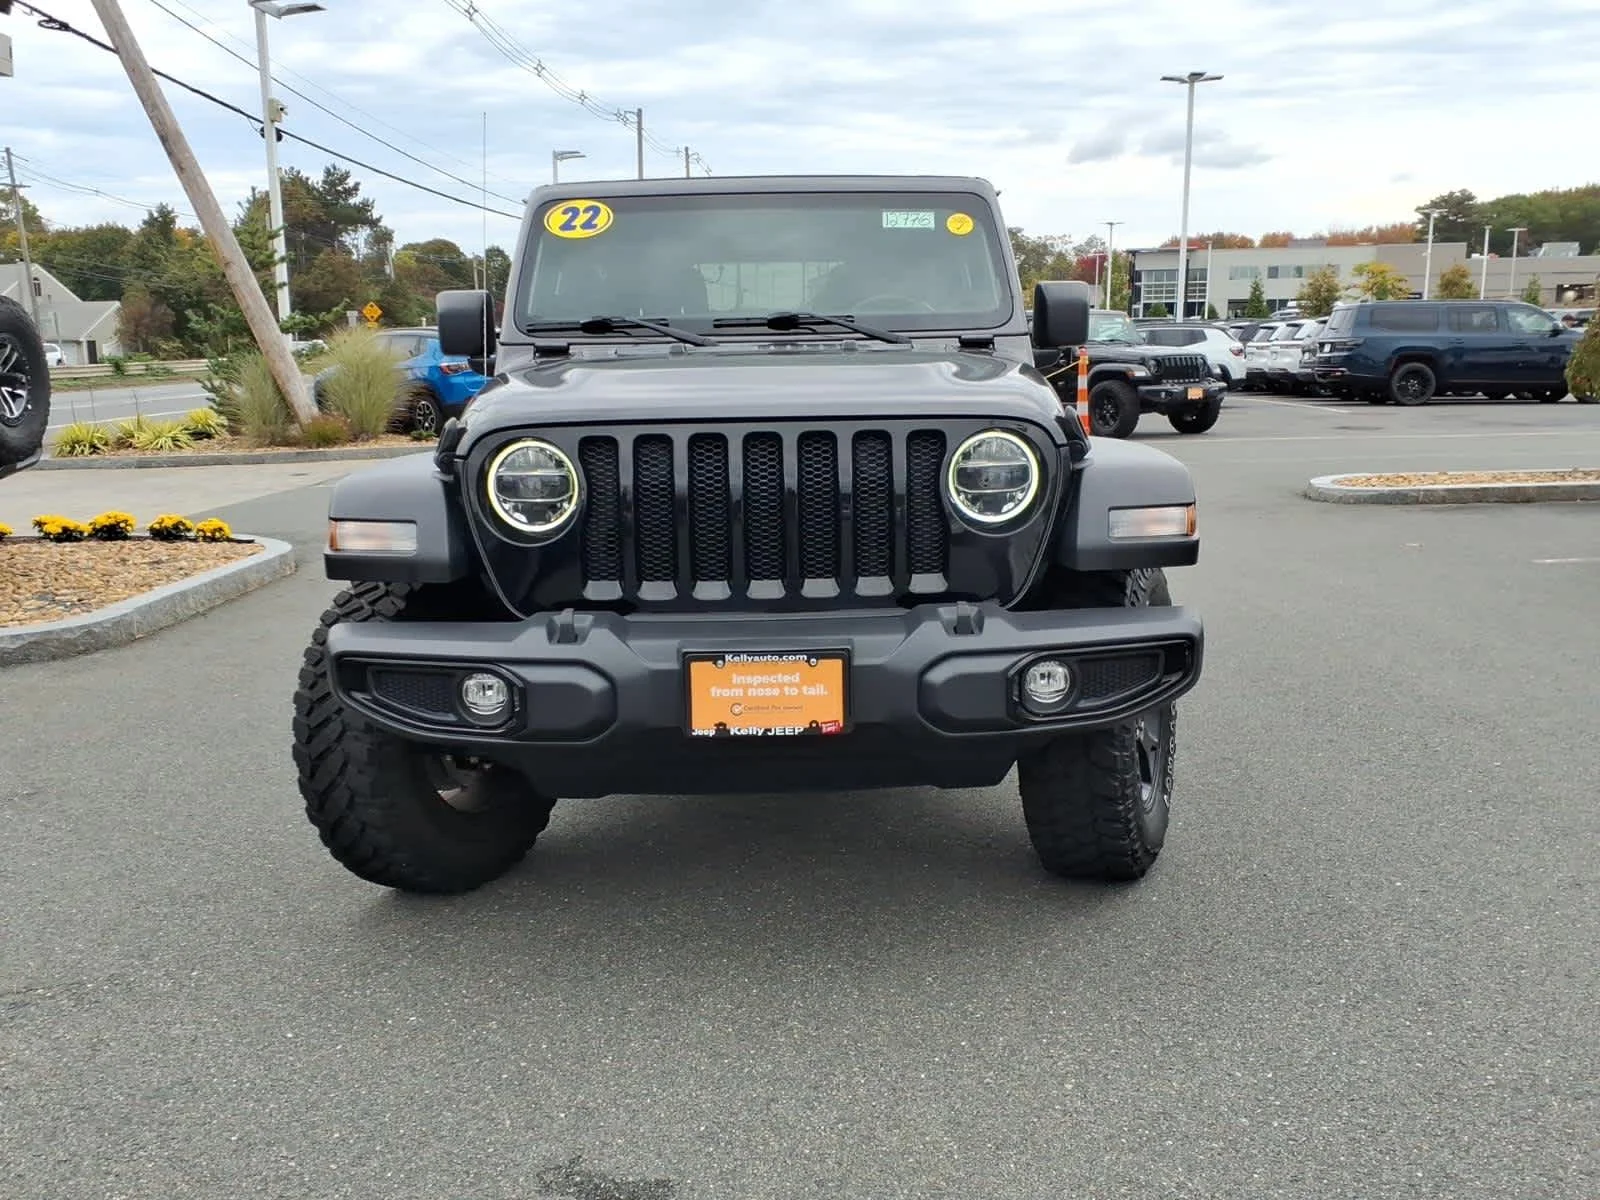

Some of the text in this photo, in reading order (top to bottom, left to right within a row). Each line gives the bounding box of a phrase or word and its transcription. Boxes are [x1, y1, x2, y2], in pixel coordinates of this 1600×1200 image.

[559, 205, 601, 231] 22
[725, 653, 807, 663] Kellyauto.com
[732, 672, 800, 685] Inspected
[710, 684, 828, 697] from nose to tail.
[691, 728, 716, 737] Jeep
[730, 726, 804, 736] Kelly JEEP
